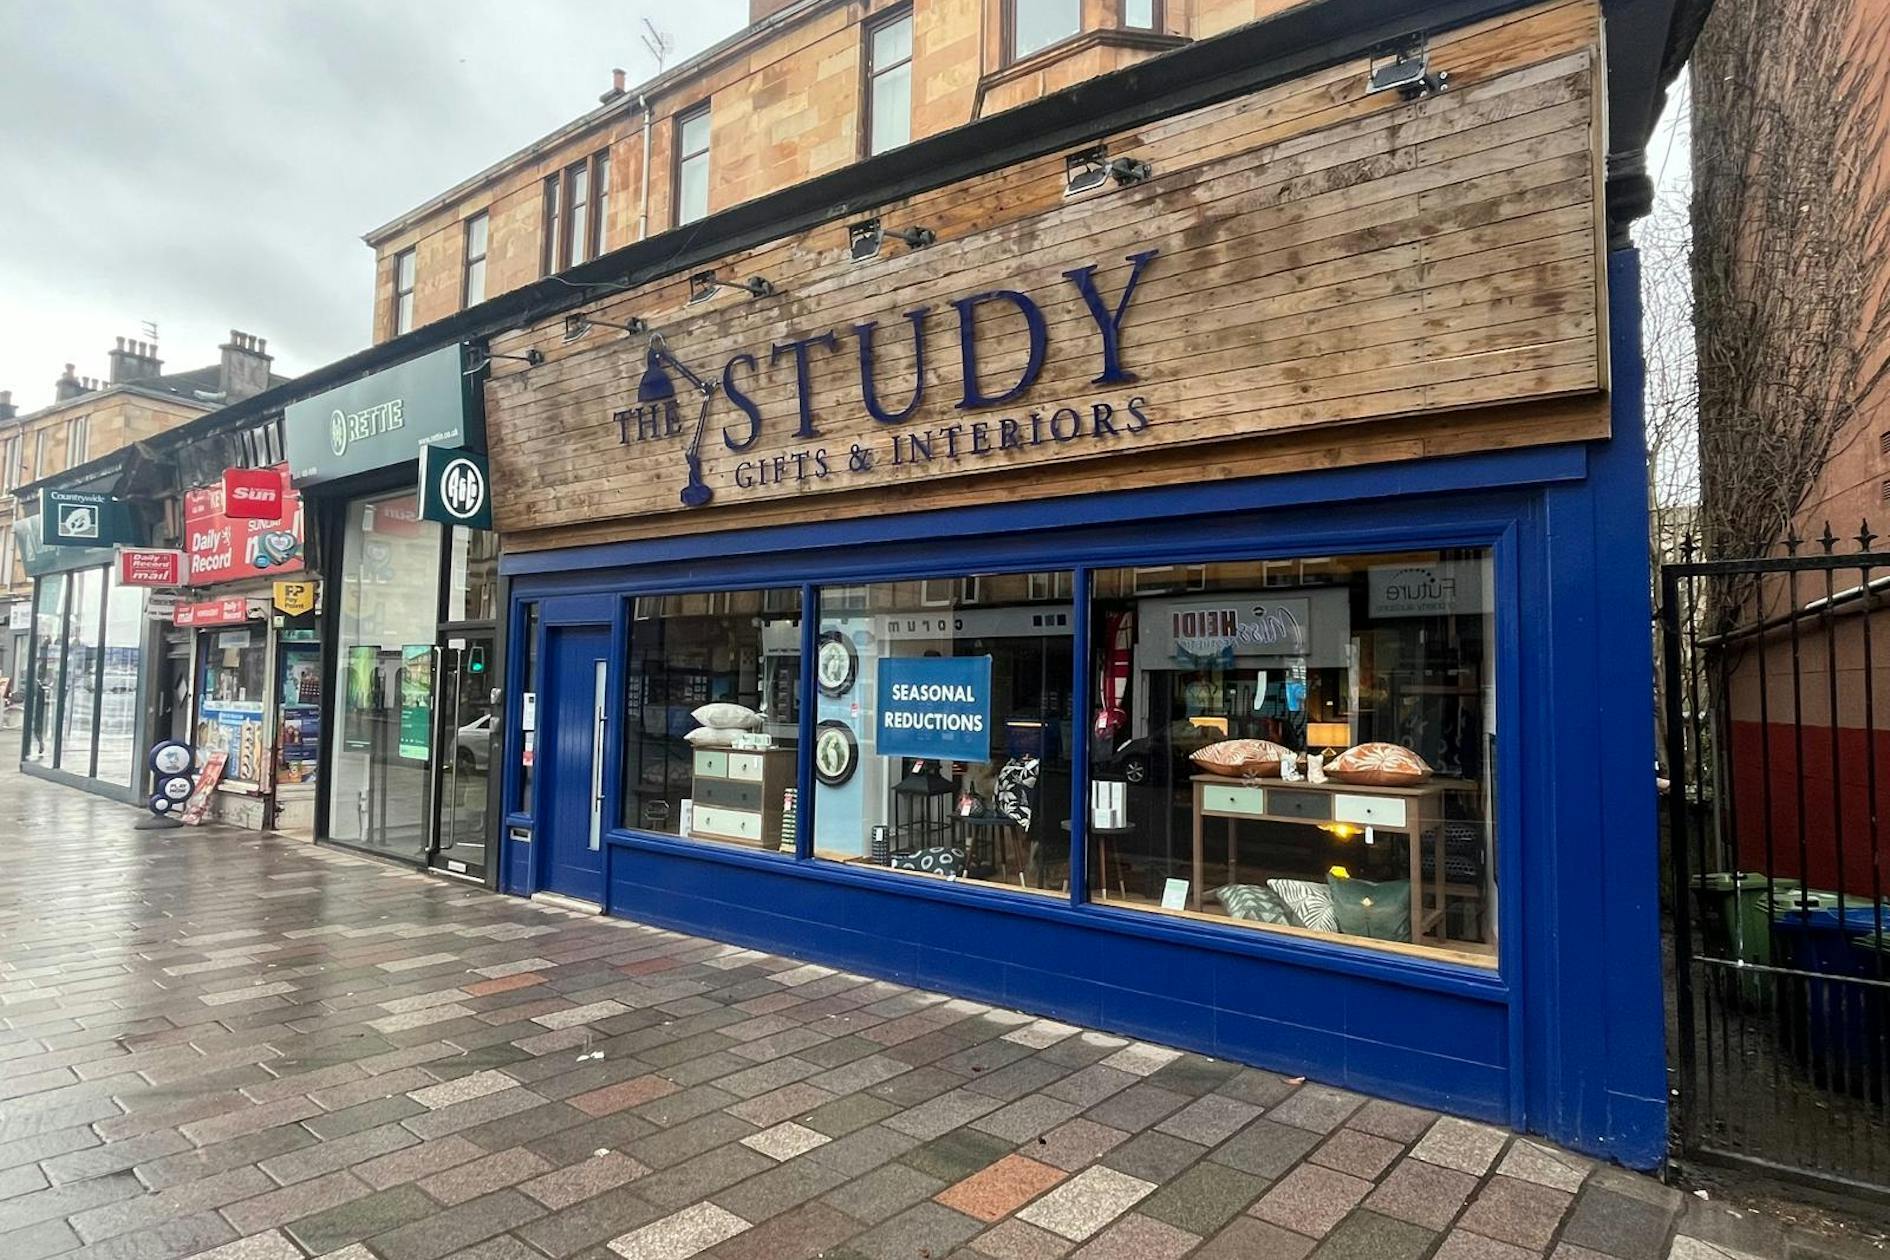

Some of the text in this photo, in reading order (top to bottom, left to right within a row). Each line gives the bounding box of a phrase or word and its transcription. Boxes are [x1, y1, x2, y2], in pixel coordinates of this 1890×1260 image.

[722, 248, 1159, 453] STUDY
[348, 399, 404, 442] RETTIE
[613, 400, 682, 444] THE
[735, 396, 1151, 490] GIFTS & INTERIORS
[51, 491, 105, 504] Countrywide
[191, 528, 222, 553] Daily
[133, 554, 160, 562] Daily
[191, 547, 232, 574] Record
[132, 570, 169, 580] mail
[891, 683, 976, 703] SEASONAL
[884, 711, 984, 732] REDUCTIONS
